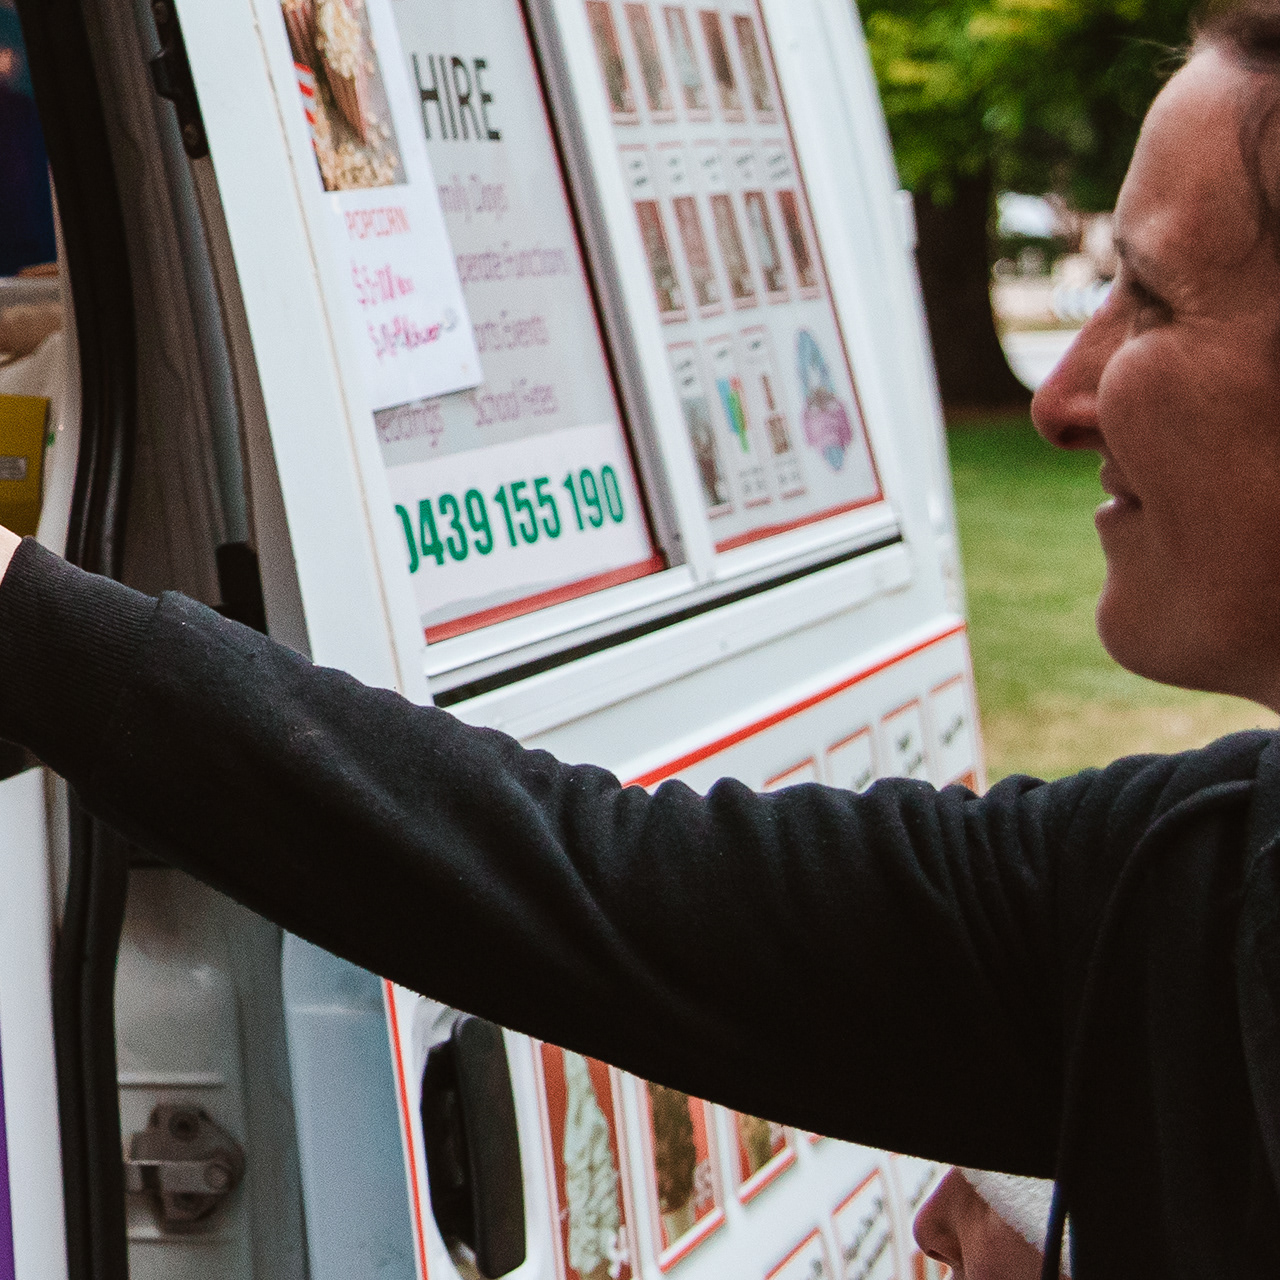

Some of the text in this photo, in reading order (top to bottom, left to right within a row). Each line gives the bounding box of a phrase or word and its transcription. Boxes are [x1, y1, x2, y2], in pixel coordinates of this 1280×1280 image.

[412, 51, 503, 142] HIRE
[494, 477, 561, 548] 155
[563, 465, 624, 530] 190
